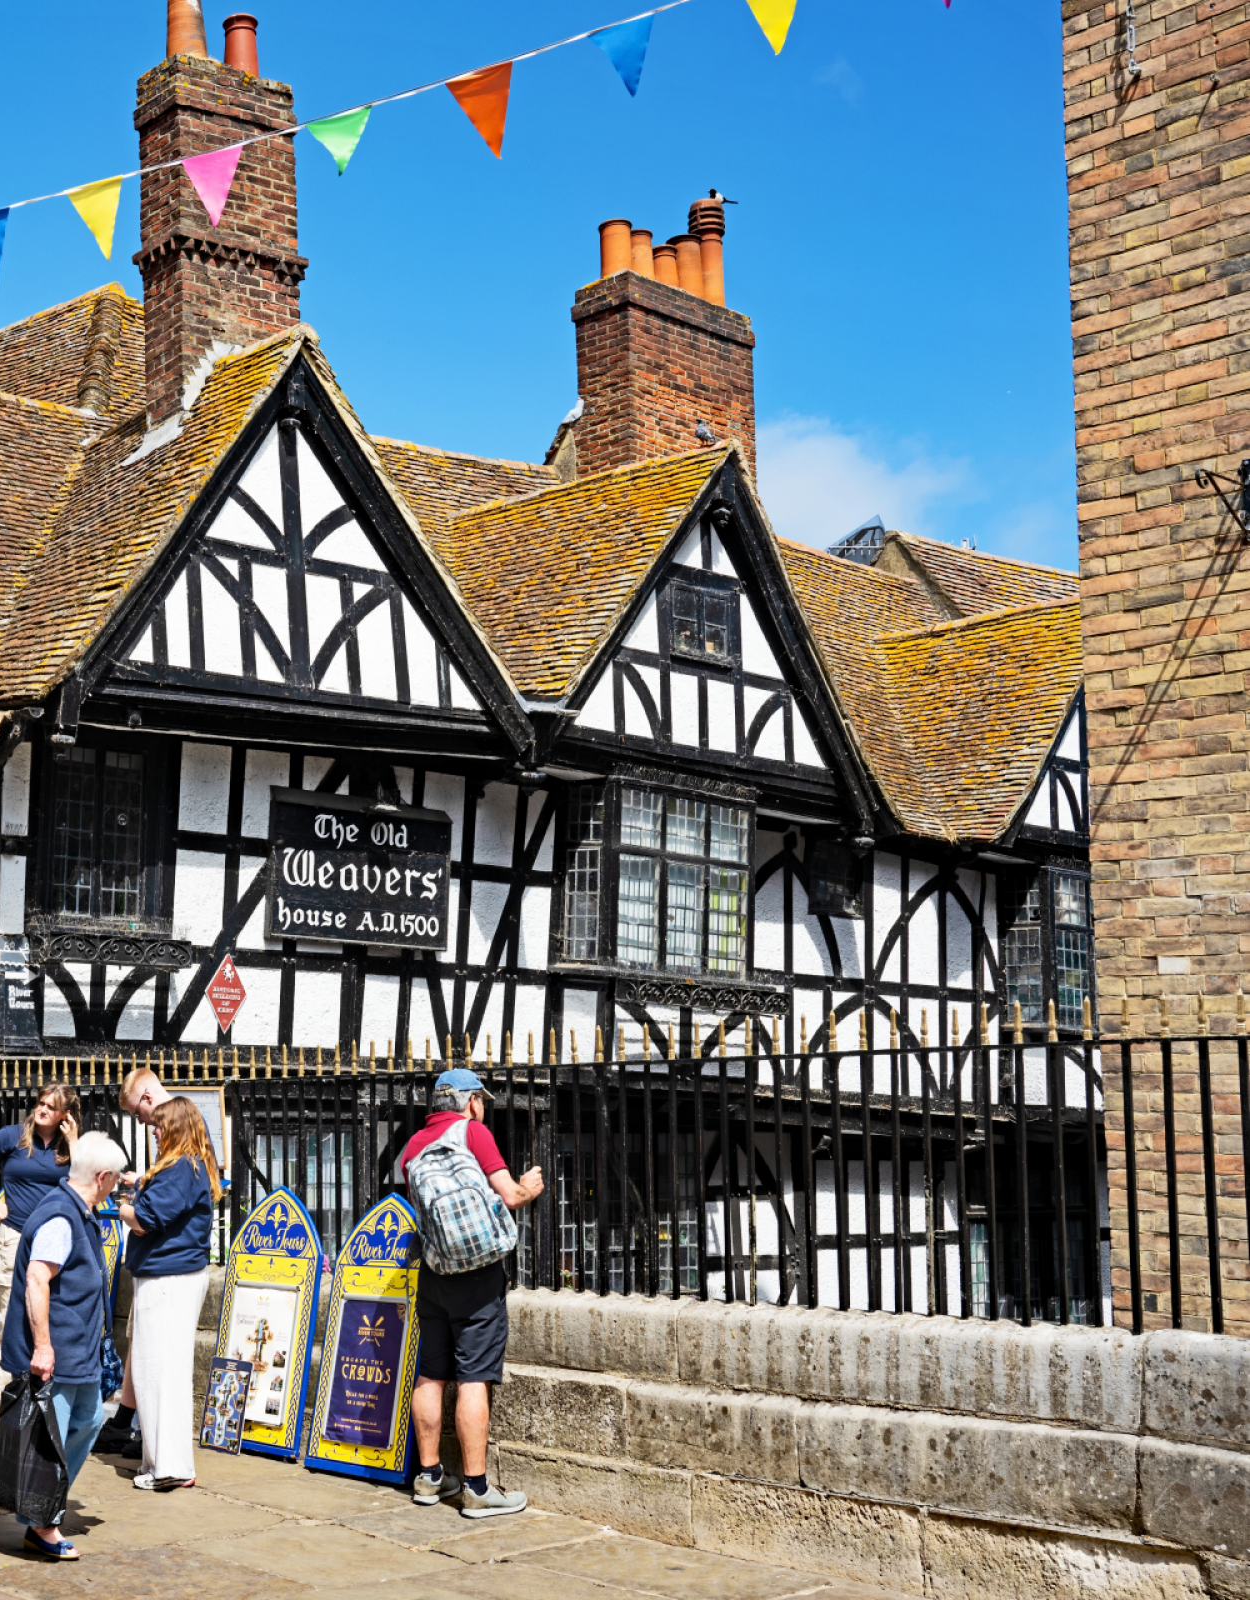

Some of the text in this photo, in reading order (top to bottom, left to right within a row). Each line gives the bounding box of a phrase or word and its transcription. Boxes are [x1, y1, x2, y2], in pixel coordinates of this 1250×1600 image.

[315, 814, 409, 849] The Old
[283, 847, 442, 900] Weavers'
[277, 896, 347, 930] house
[8, 985, 33, 997] River
[8, 997, 35, 1009] Tours
[244, 1224, 307, 1251] River Tours
[352, 1235, 382, 1260] River
[341, 1356, 367, 1364] ESCAPE
[341, 1364, 391, 1384] CROWDS
